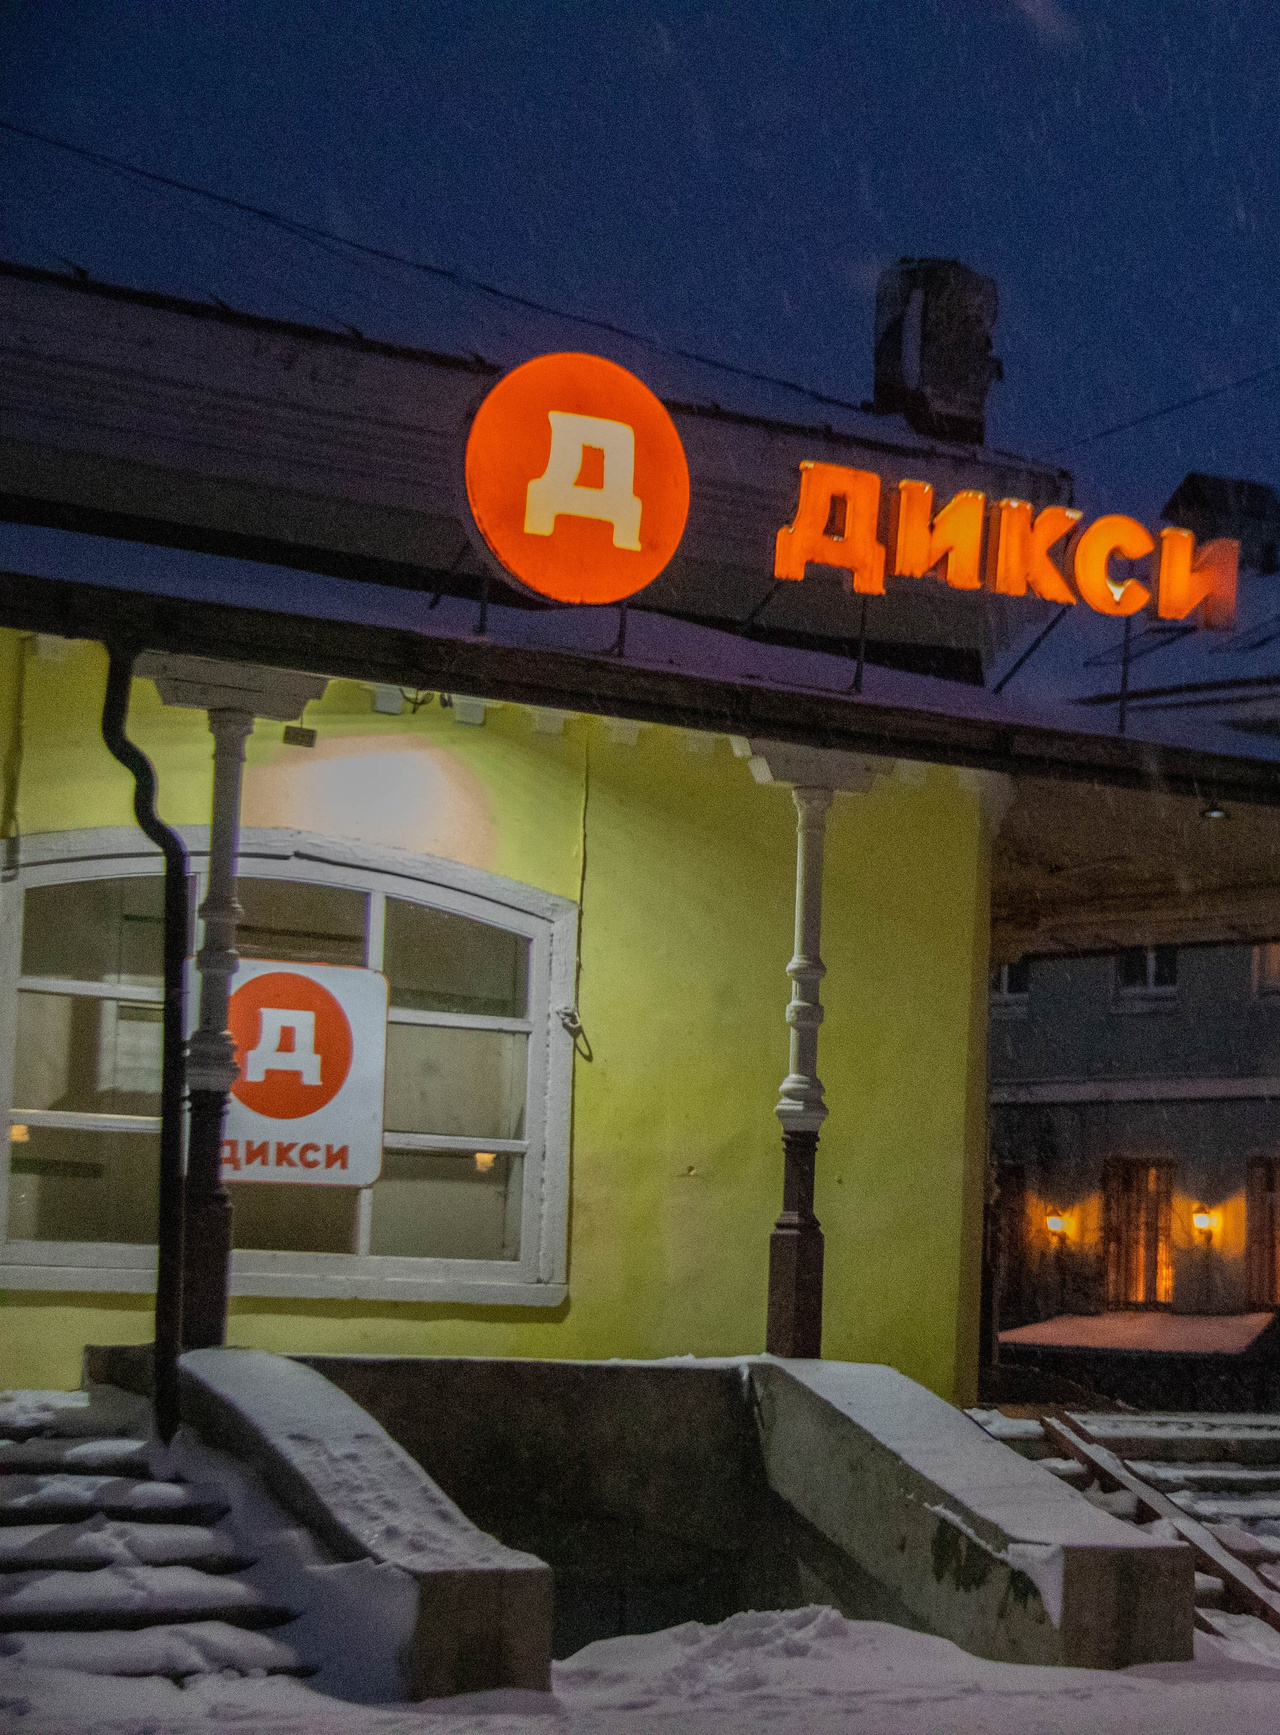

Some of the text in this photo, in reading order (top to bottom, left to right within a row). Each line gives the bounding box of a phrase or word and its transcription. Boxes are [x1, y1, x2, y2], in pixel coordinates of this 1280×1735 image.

[524, 410, 642, 552] Д
[774, 459, 1240, 626] ДИКСИ
[246, 1007, 322, 1086] Д
